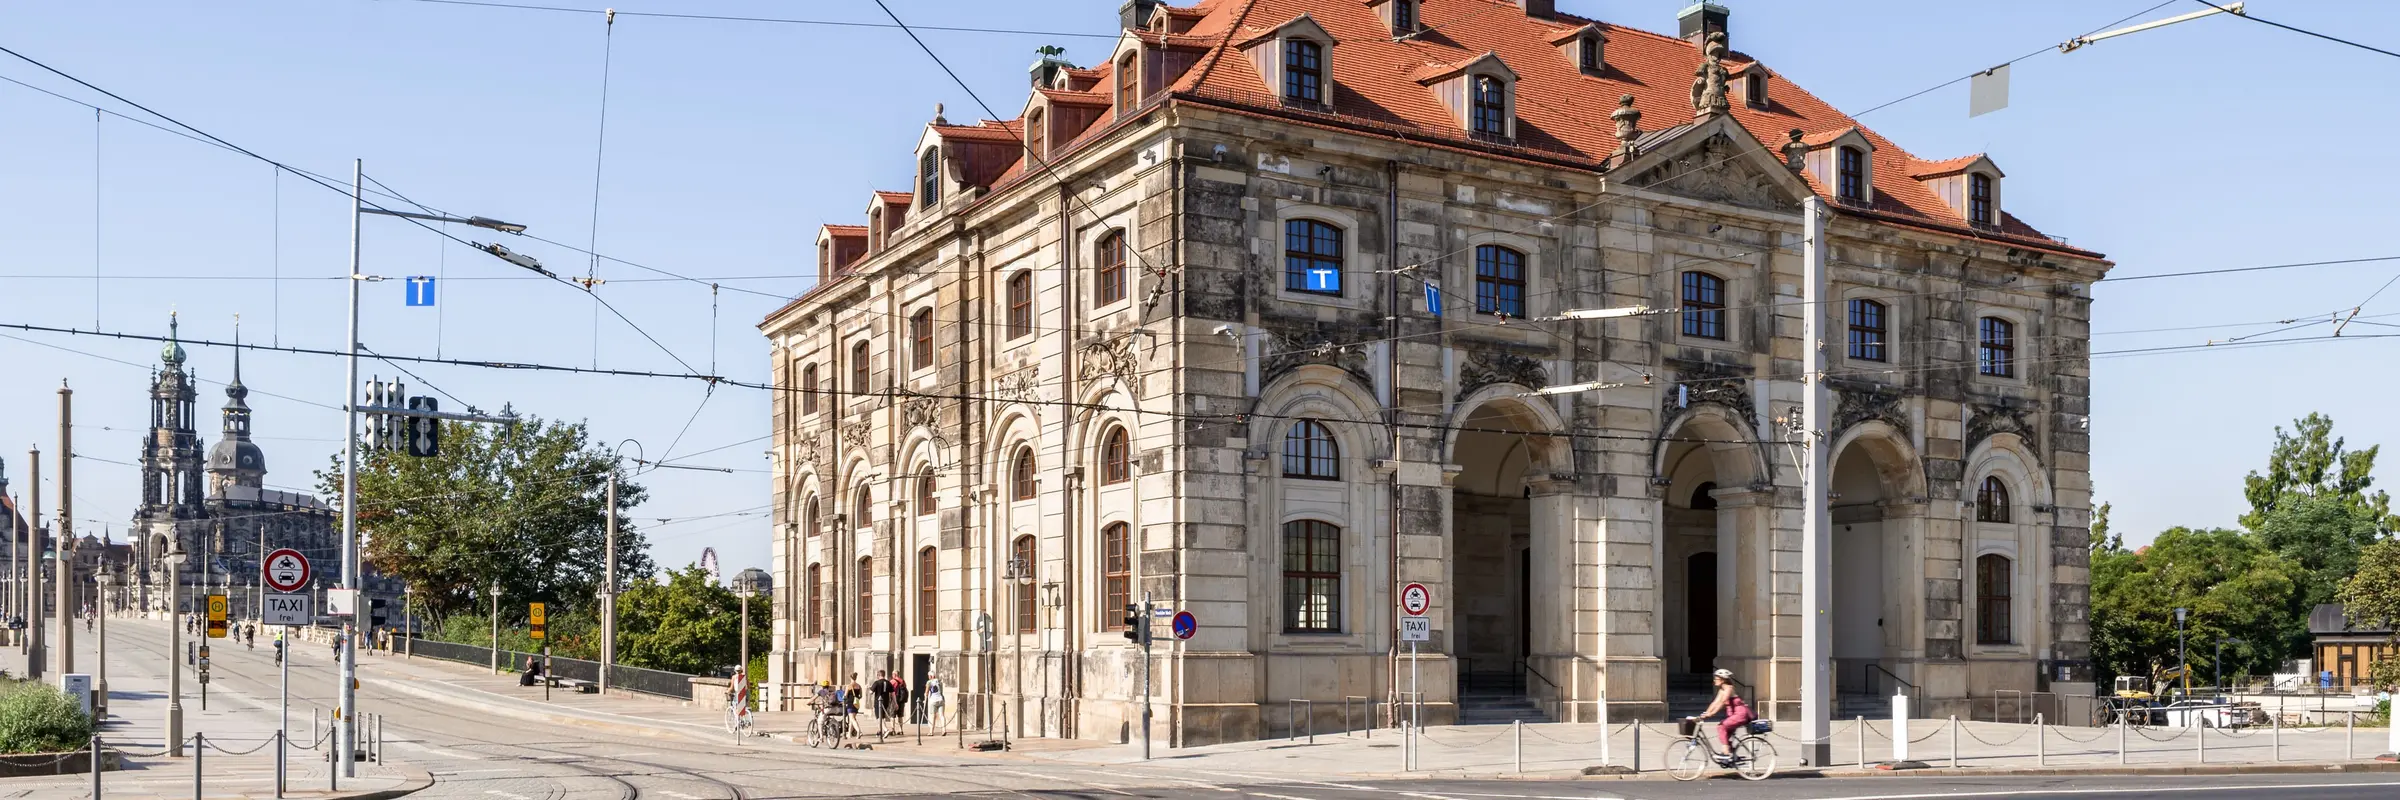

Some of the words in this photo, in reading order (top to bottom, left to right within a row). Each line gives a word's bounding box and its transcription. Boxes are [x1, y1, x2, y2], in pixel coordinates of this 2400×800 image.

[1313, 270, 1332, 288] T
[412, 278, 429, 304] T
[1428, 286, 1437, 311] T
[269, 599, 303, 611] TAXI
[280, 614, 294, 622] frei
[1405, 621, 1426, 631] TAXI
